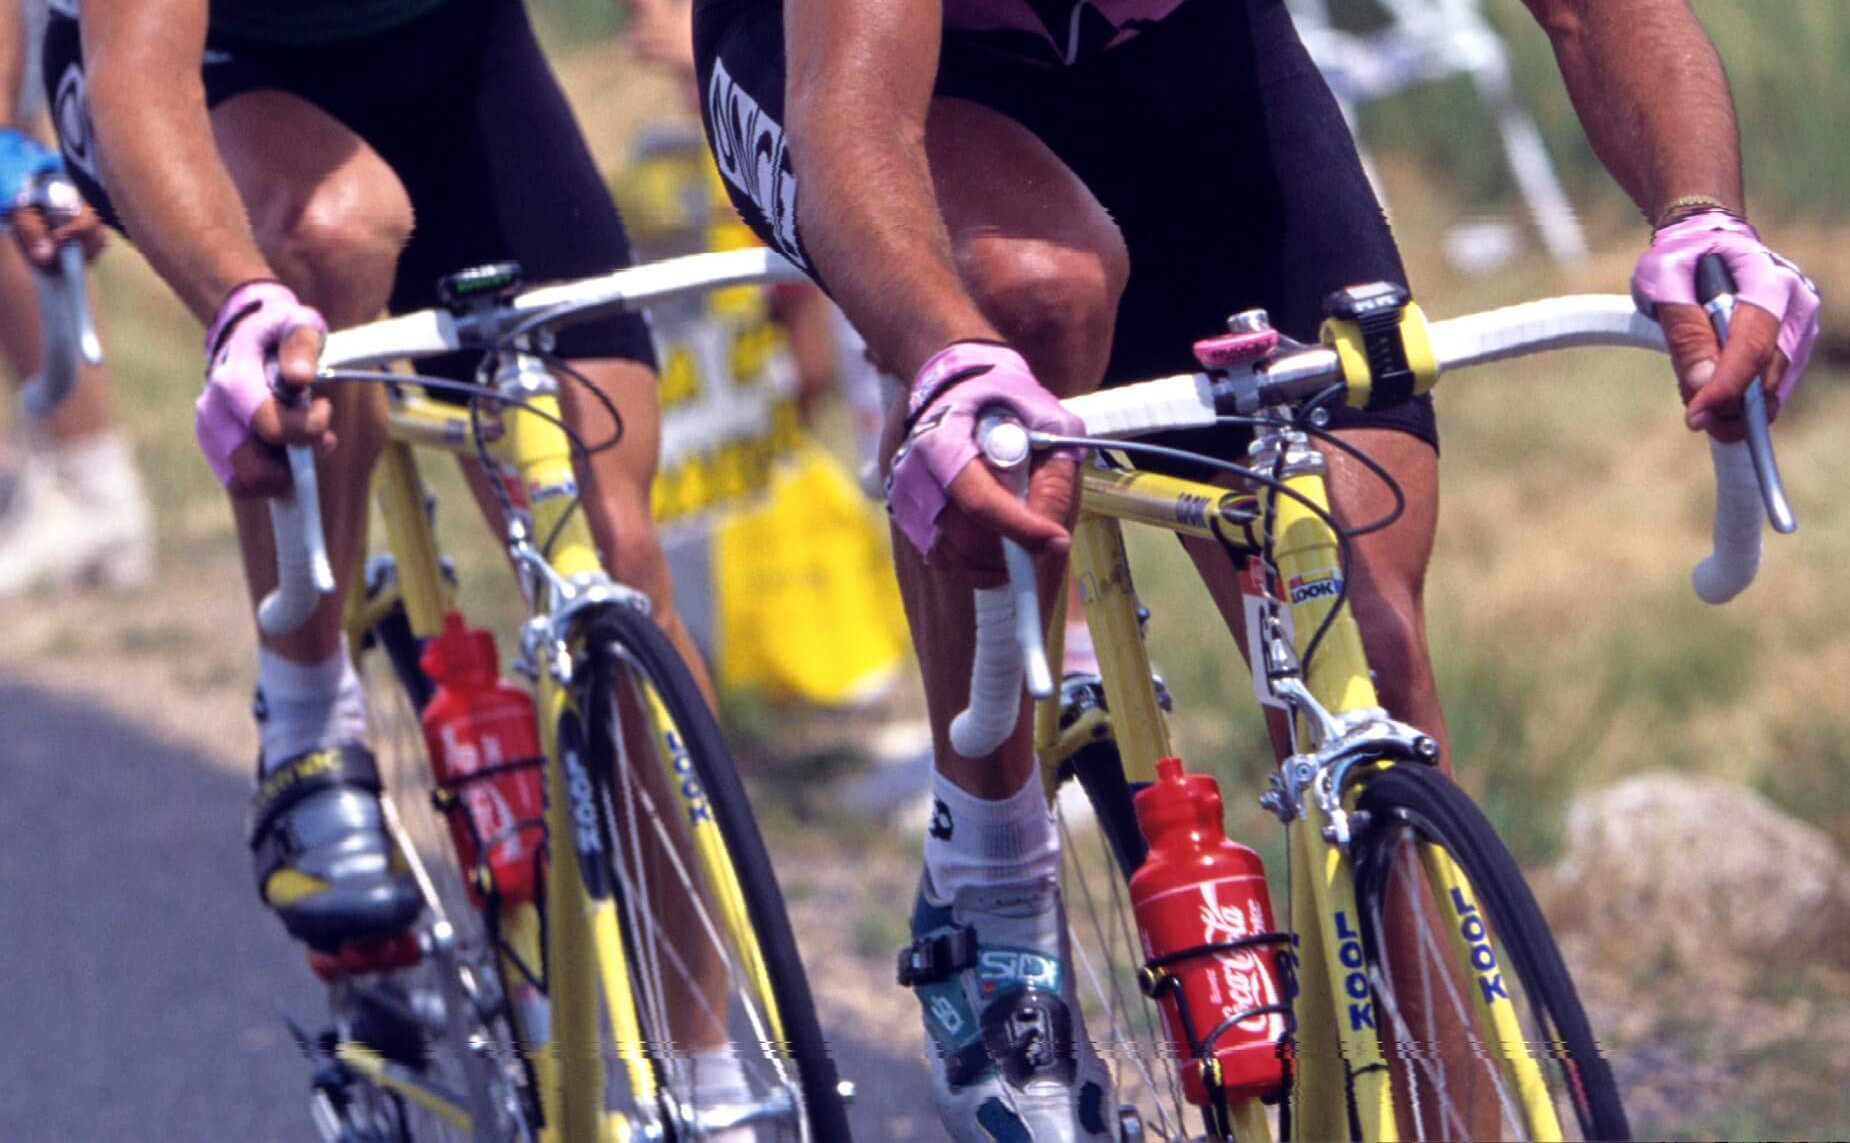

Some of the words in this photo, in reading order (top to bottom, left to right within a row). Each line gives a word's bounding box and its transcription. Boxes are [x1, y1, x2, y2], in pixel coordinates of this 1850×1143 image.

[1290, 578, 1334, 604] LOOK
[665, 730, 709, 826] LOOK
[1200, 879, 1268, 1033] Coca-Cla
[1334, 911, 1376, 1031] LOOK
[1450, 887, 1510, 1004] LOOK
